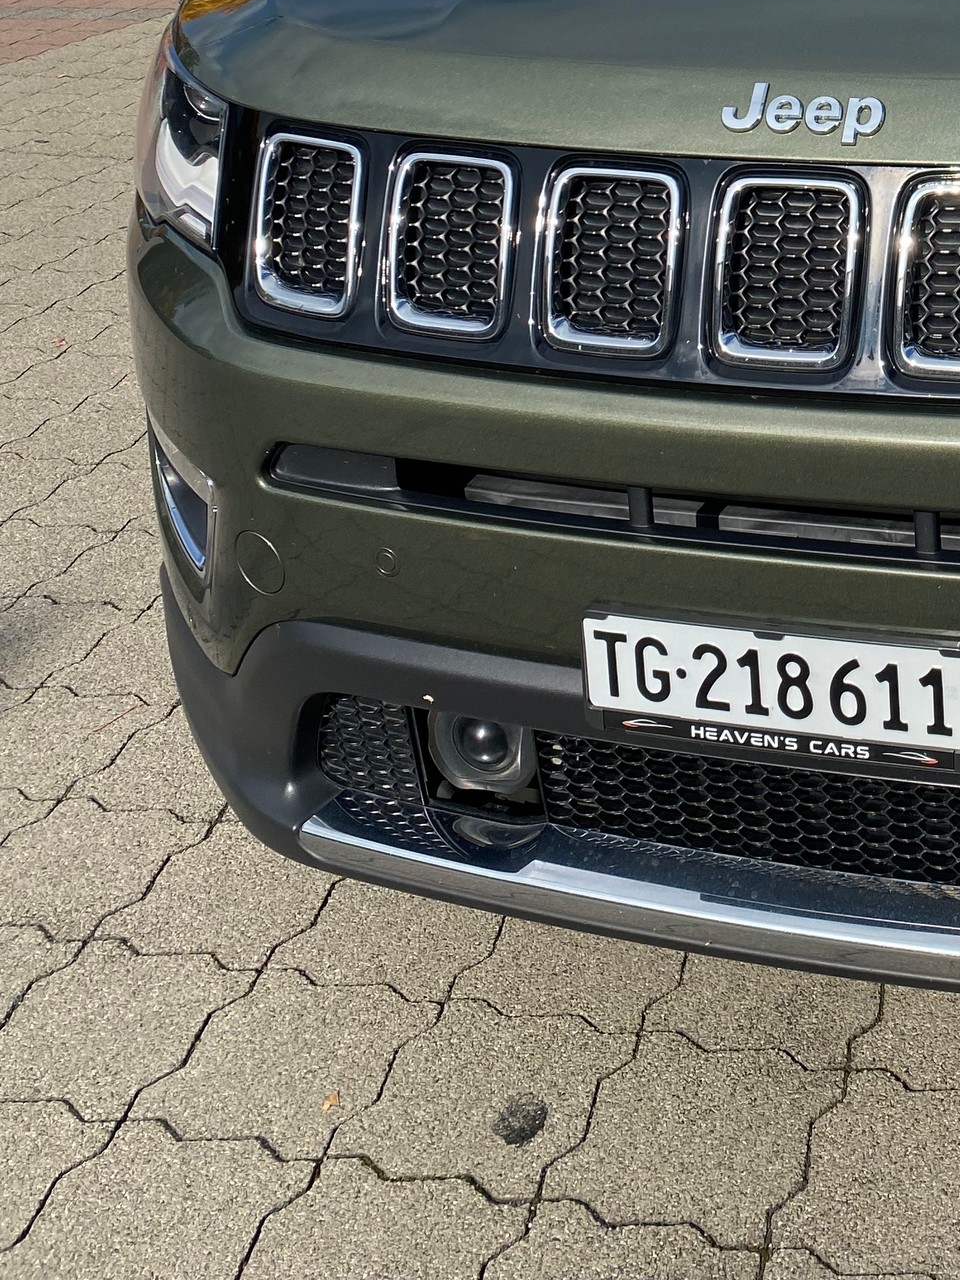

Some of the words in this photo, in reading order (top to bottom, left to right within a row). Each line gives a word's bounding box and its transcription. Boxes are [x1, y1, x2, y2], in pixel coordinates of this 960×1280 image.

[721, 82, 886, 147] Jeep
[690, 724, 798, 750] HEAVEN'S
[809, 740, 871, 760] CARS
